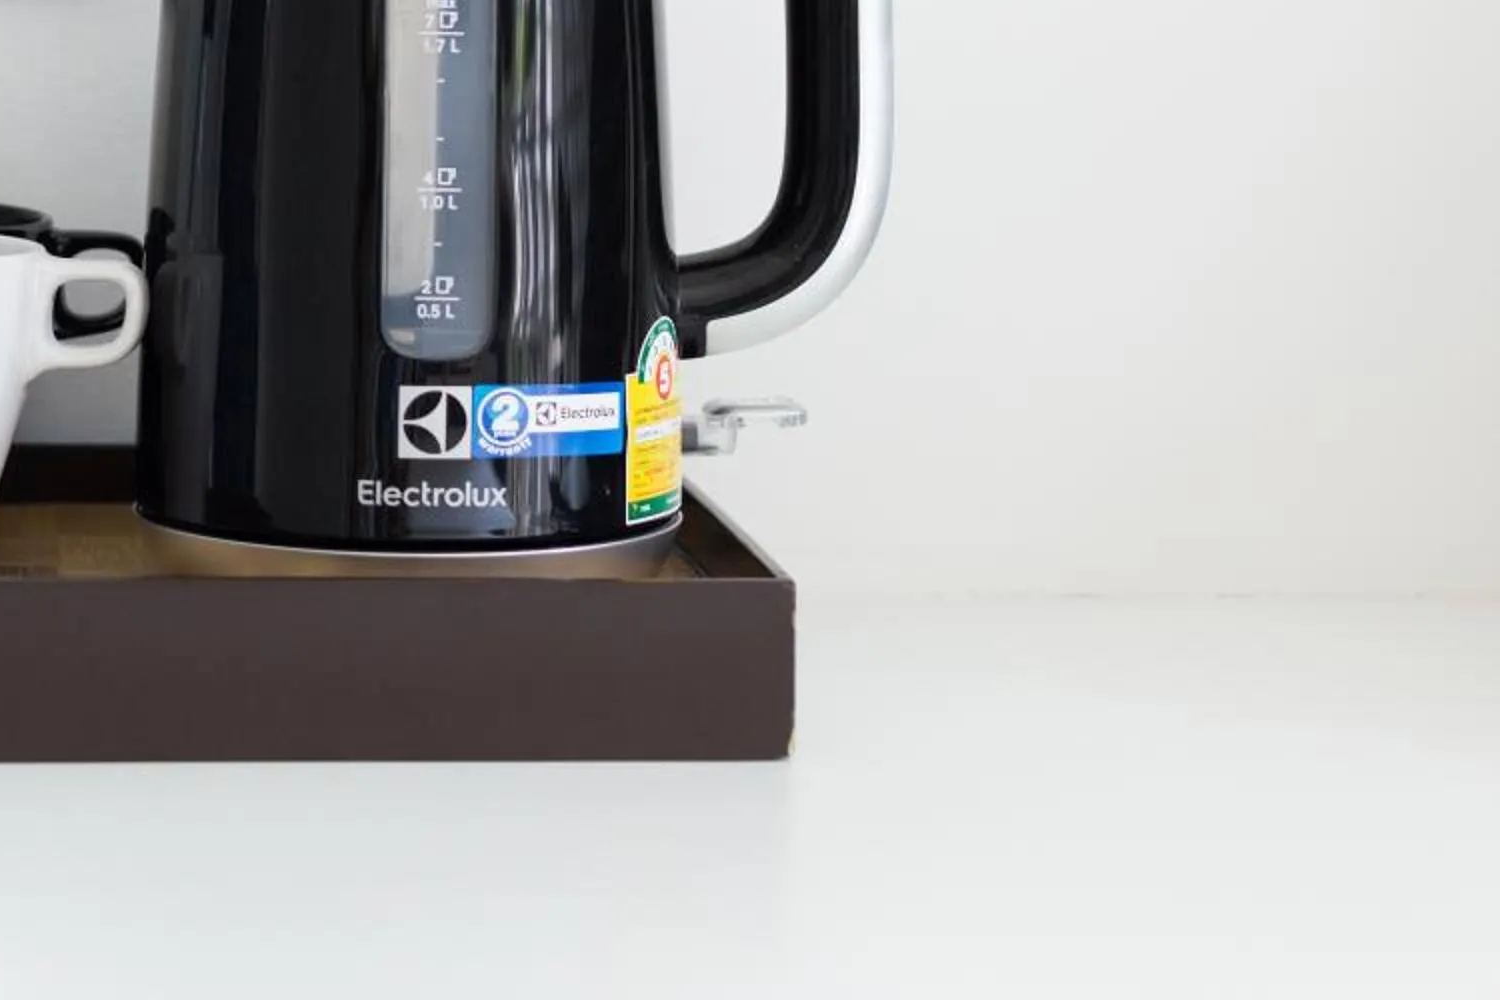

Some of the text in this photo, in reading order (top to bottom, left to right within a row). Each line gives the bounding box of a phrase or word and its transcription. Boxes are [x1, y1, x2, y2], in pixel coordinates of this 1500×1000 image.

[424, 13, 435, 28] 7
[450, 38, 461, 53] L
[422, 170, 434, 186] 4
[420, 195, 459, 210] 1.0 L
[421, 279, 432, 294] 2
[416, 303, 456, 319] 0.5 L
[491, 395, 519, 431] 2
[560, 403, 615, 419] Electrolux
[357, 480, 507, 508] Electrolux
